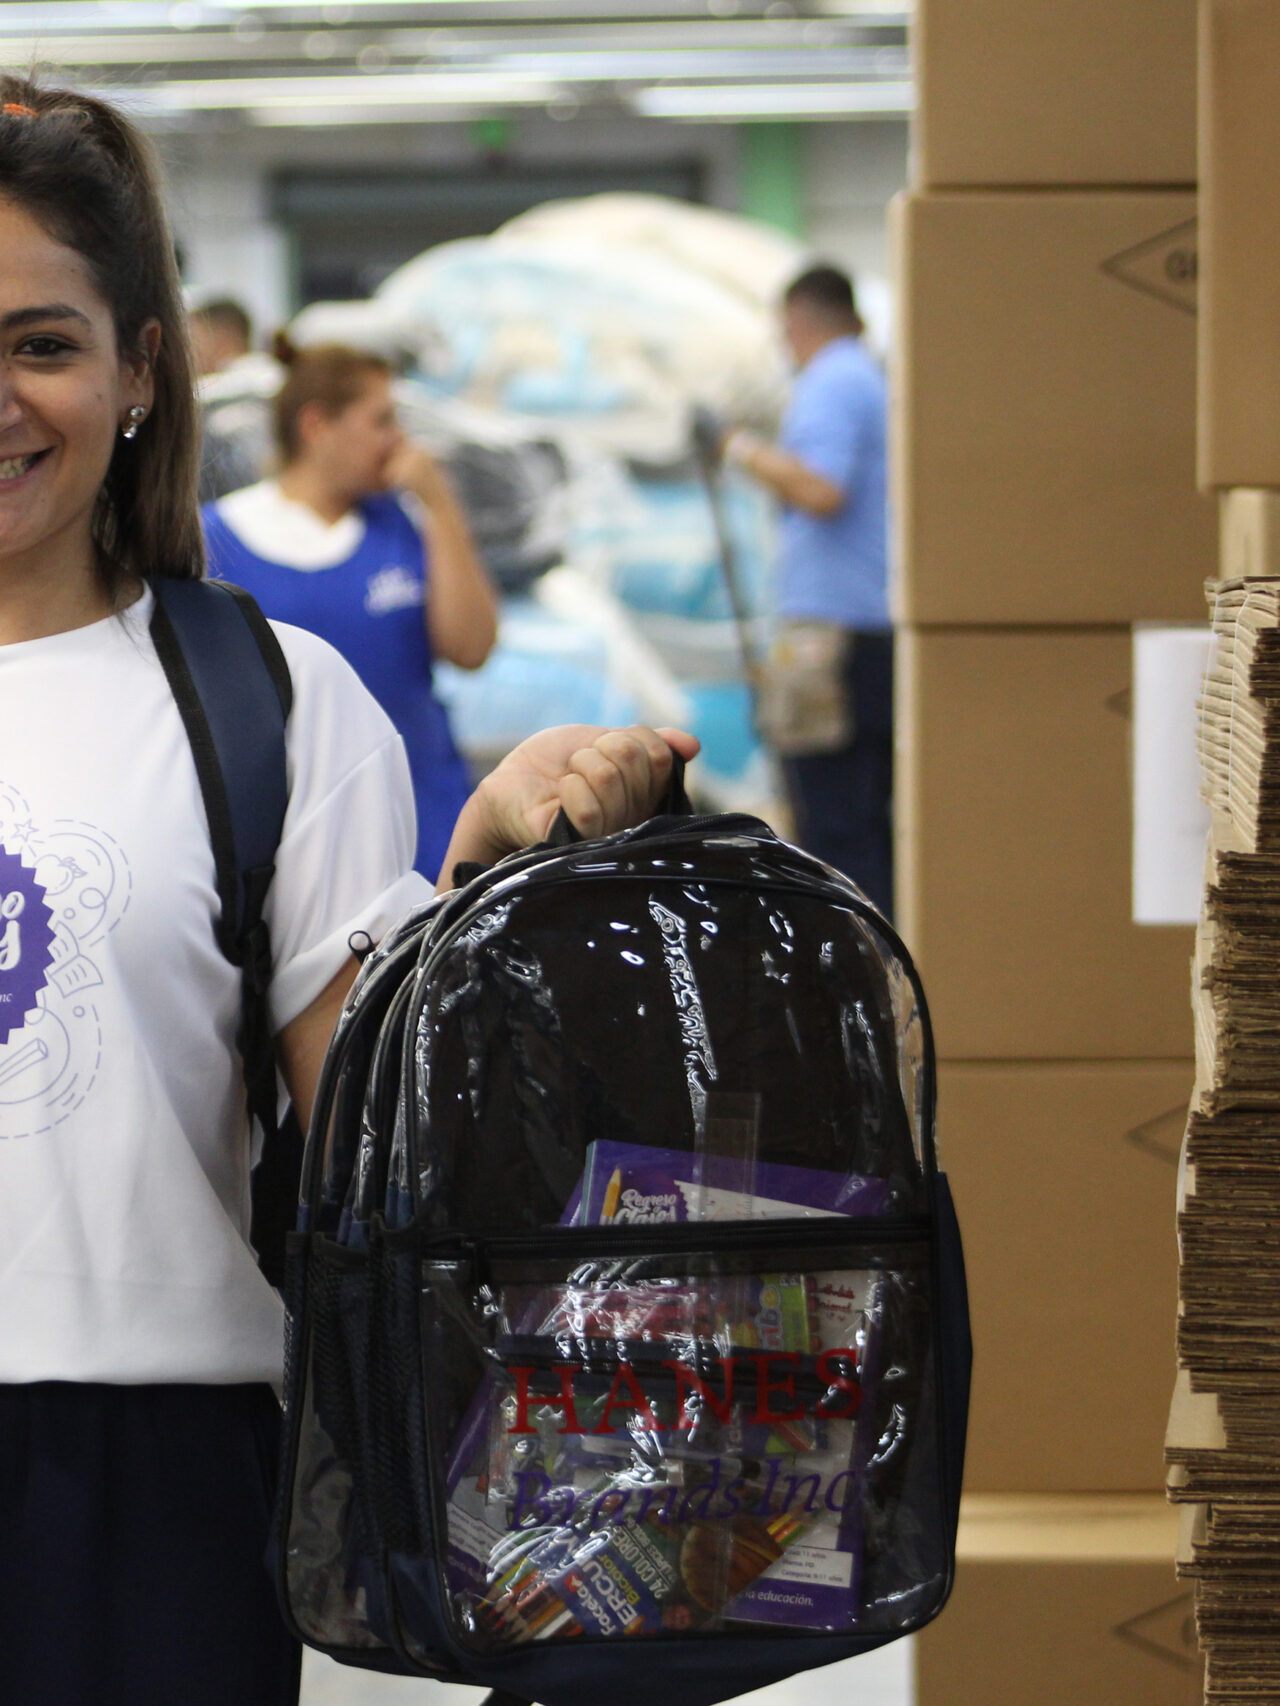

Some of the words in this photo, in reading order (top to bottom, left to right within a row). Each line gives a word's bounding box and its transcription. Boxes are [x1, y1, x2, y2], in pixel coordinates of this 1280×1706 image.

[620, 1188, 678, 1213] Regreso
[509, 1348, 864, 1436] HANES
[504, 1458, 746, 1532] Brands
[752, 1459, 860, 1516] Inc
[597, 1554, 640, 1605] Bicolor
[757, 1589, 814, 1606] educación.
